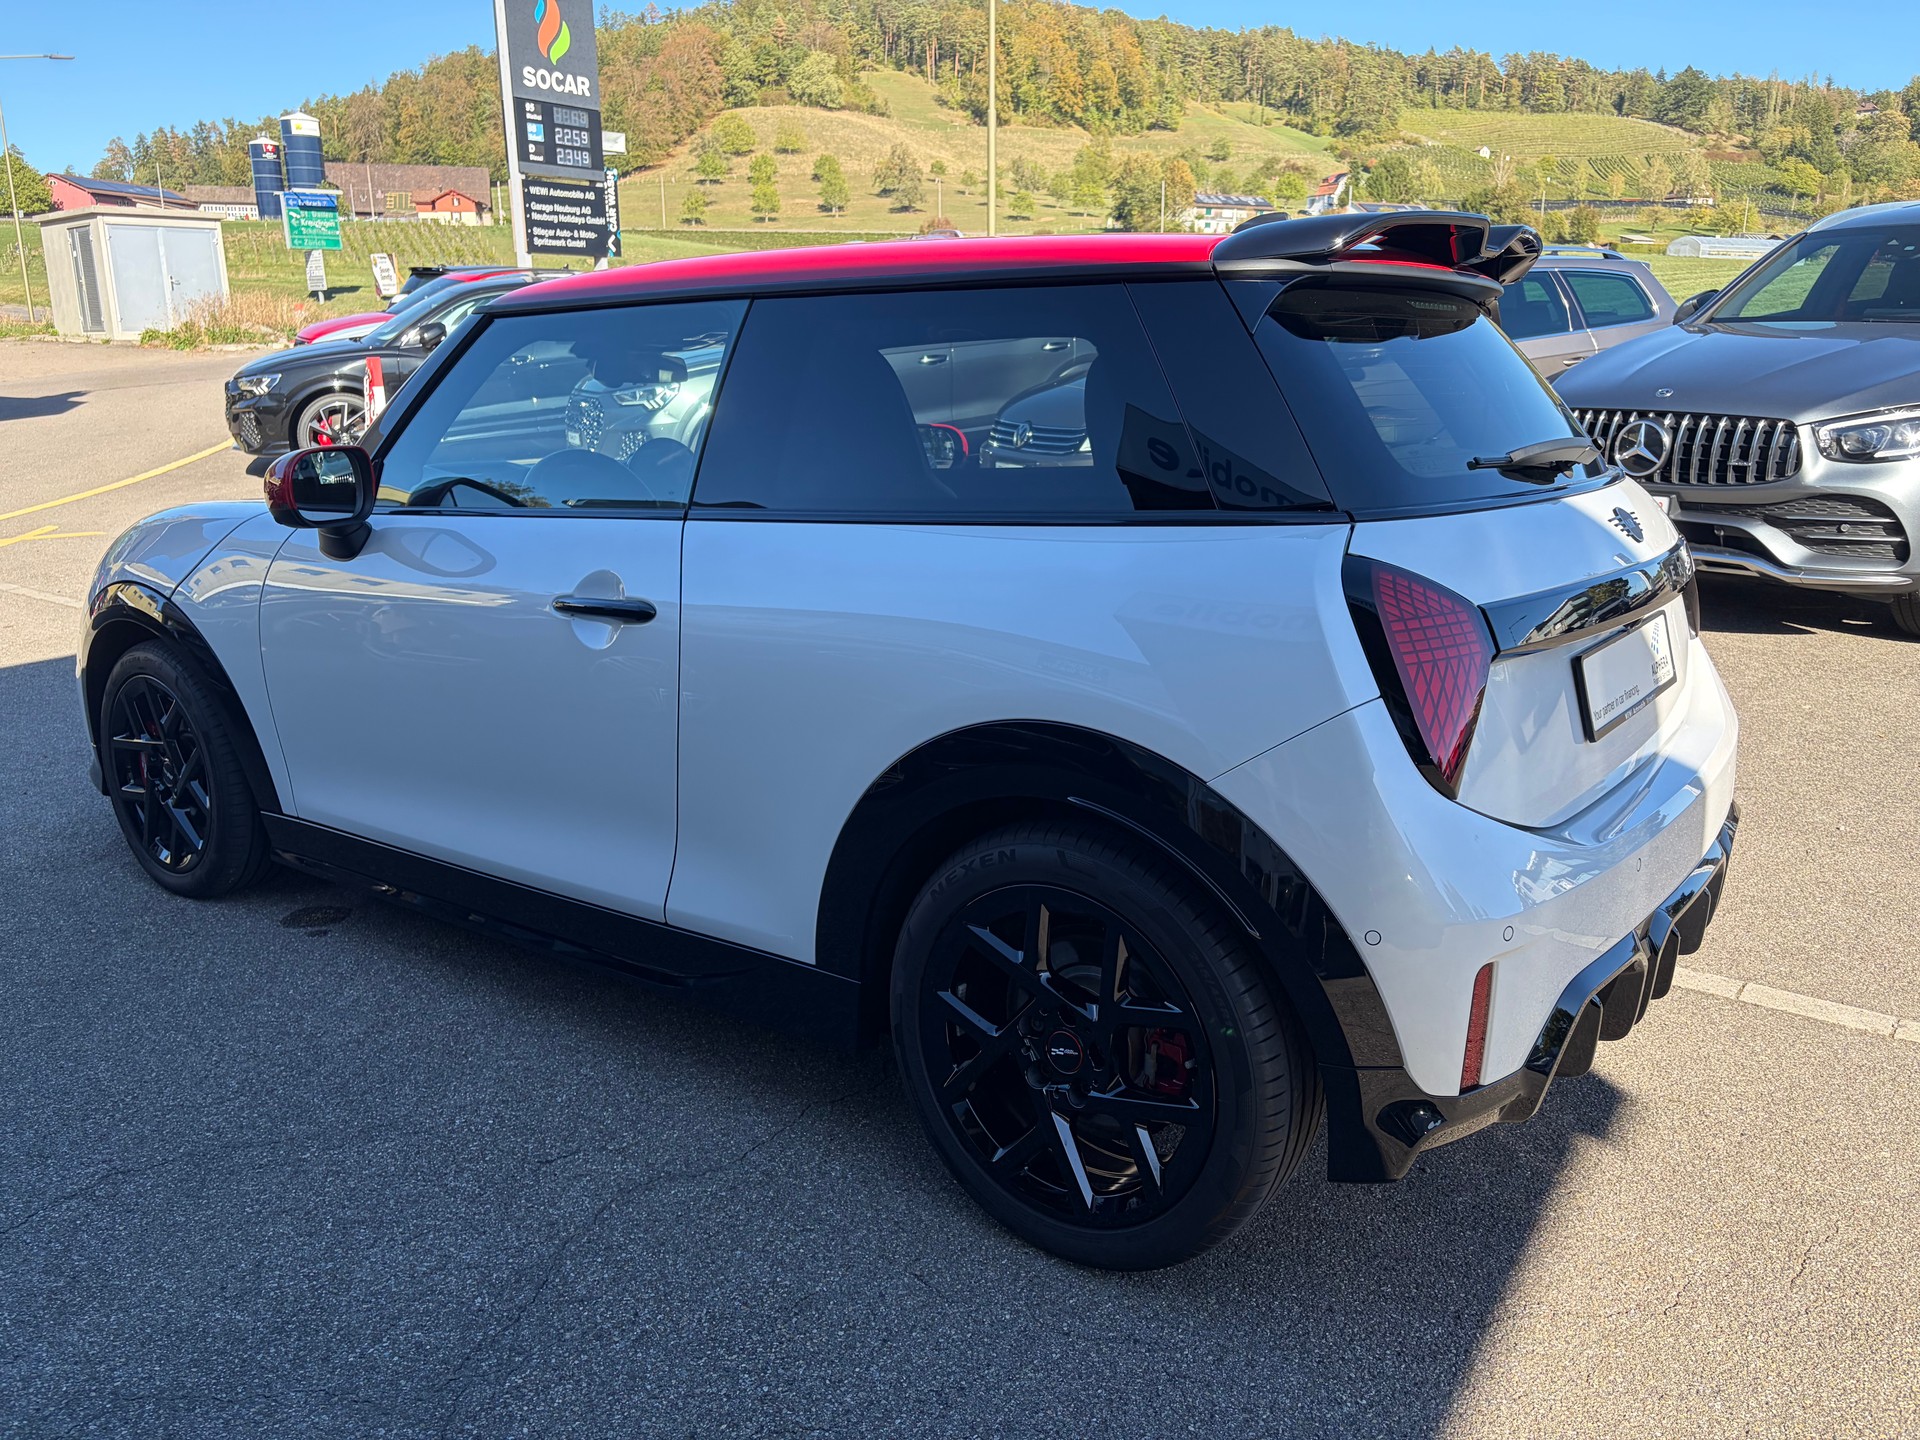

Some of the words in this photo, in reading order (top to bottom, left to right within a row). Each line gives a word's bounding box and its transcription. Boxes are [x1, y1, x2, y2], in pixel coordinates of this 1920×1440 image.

[522, 66, 591, 97] SOCAR
[528, 143, 536, 153] D
[549, 188, 584, 199] Automobile
[584, 191, 595, 200] AG
[606, 171, 616, 206] WASH
[530, 201, 553, 212] Garage
[554, 204, 581, 215] Neuburg
[581, 206, 592, 215] AG
[531, 212, 558, 223] Neuburg
[559, 214, 586, 225] Holidays
[586, 217, 606, 226] GmbH
[609, 207, 618, 232] CAR
[304, 238, 327, 247] Zürich
[533, 237, 566, 247] Spritzwerk
[567, 239, 586, 248] GmbH
[1593, 708, 1602, 722] Your
[1602, 699, 1615, 719] partner
[929, 848, 1017, 903] NEXEN
